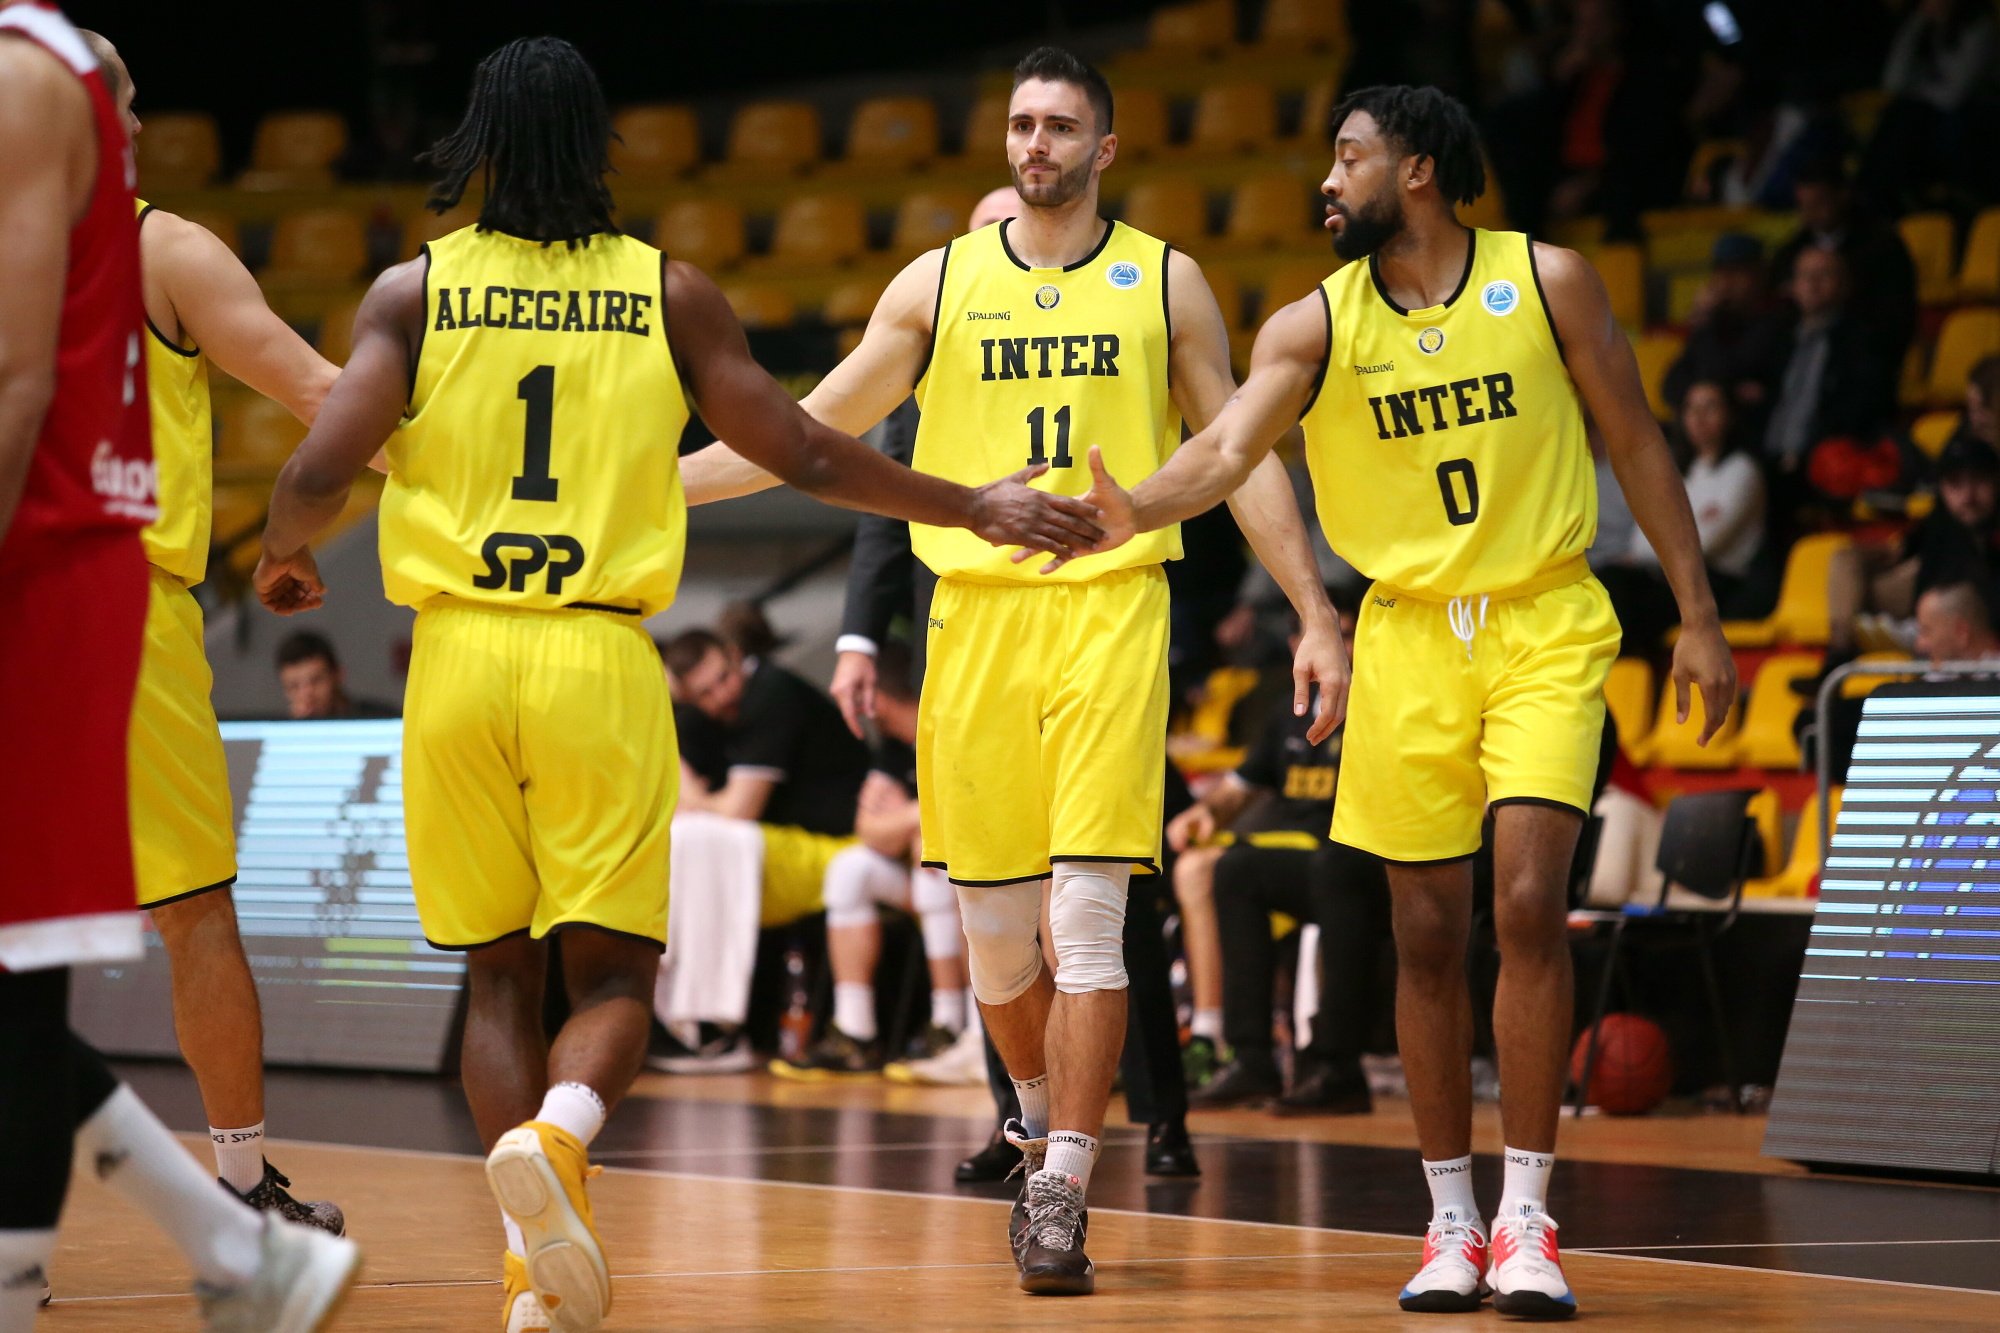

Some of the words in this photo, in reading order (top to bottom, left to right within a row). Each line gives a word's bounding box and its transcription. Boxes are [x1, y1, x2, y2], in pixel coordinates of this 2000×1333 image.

[434, 287, 652, 338] ALCEGAIRE
[967, 311, 1011, 321] SPALDING
[981, 334, 1120, 381] INTER
[512, 365, 560, 502] 1
[1027, 405, 1073, 468] 11
[1368, 372, 1518, 440] INTER
[1436, 458, 1480, 526] 0
[472, 532, 585, 595] SPP
